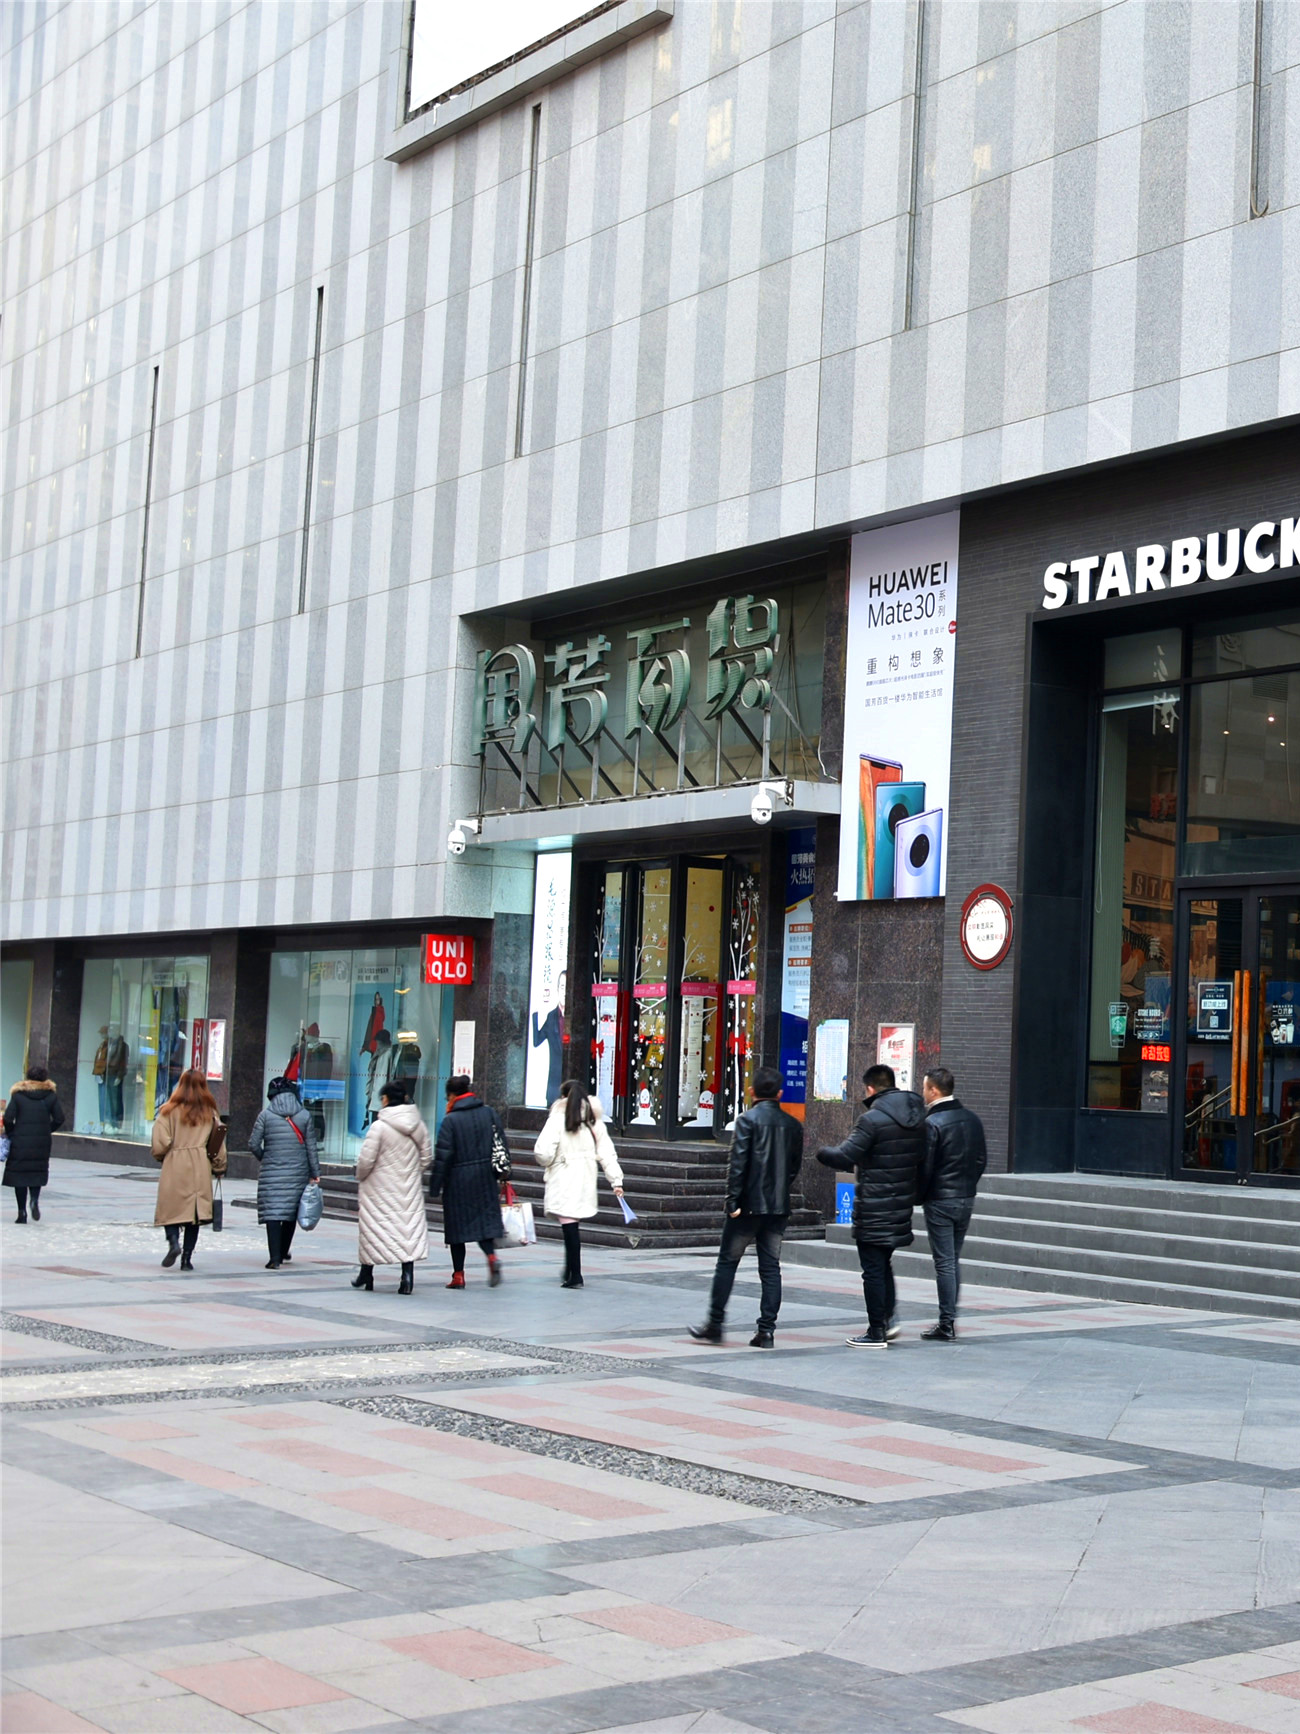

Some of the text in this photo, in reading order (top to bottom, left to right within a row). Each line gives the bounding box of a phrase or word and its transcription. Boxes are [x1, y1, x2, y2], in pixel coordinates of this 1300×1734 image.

[869, 561, 948, 598] HUAWEI
[866, 646, 944, 675] 重构想象
[431, 940, 465, 959] UNI
[431, 961, 467, 980] QLO
